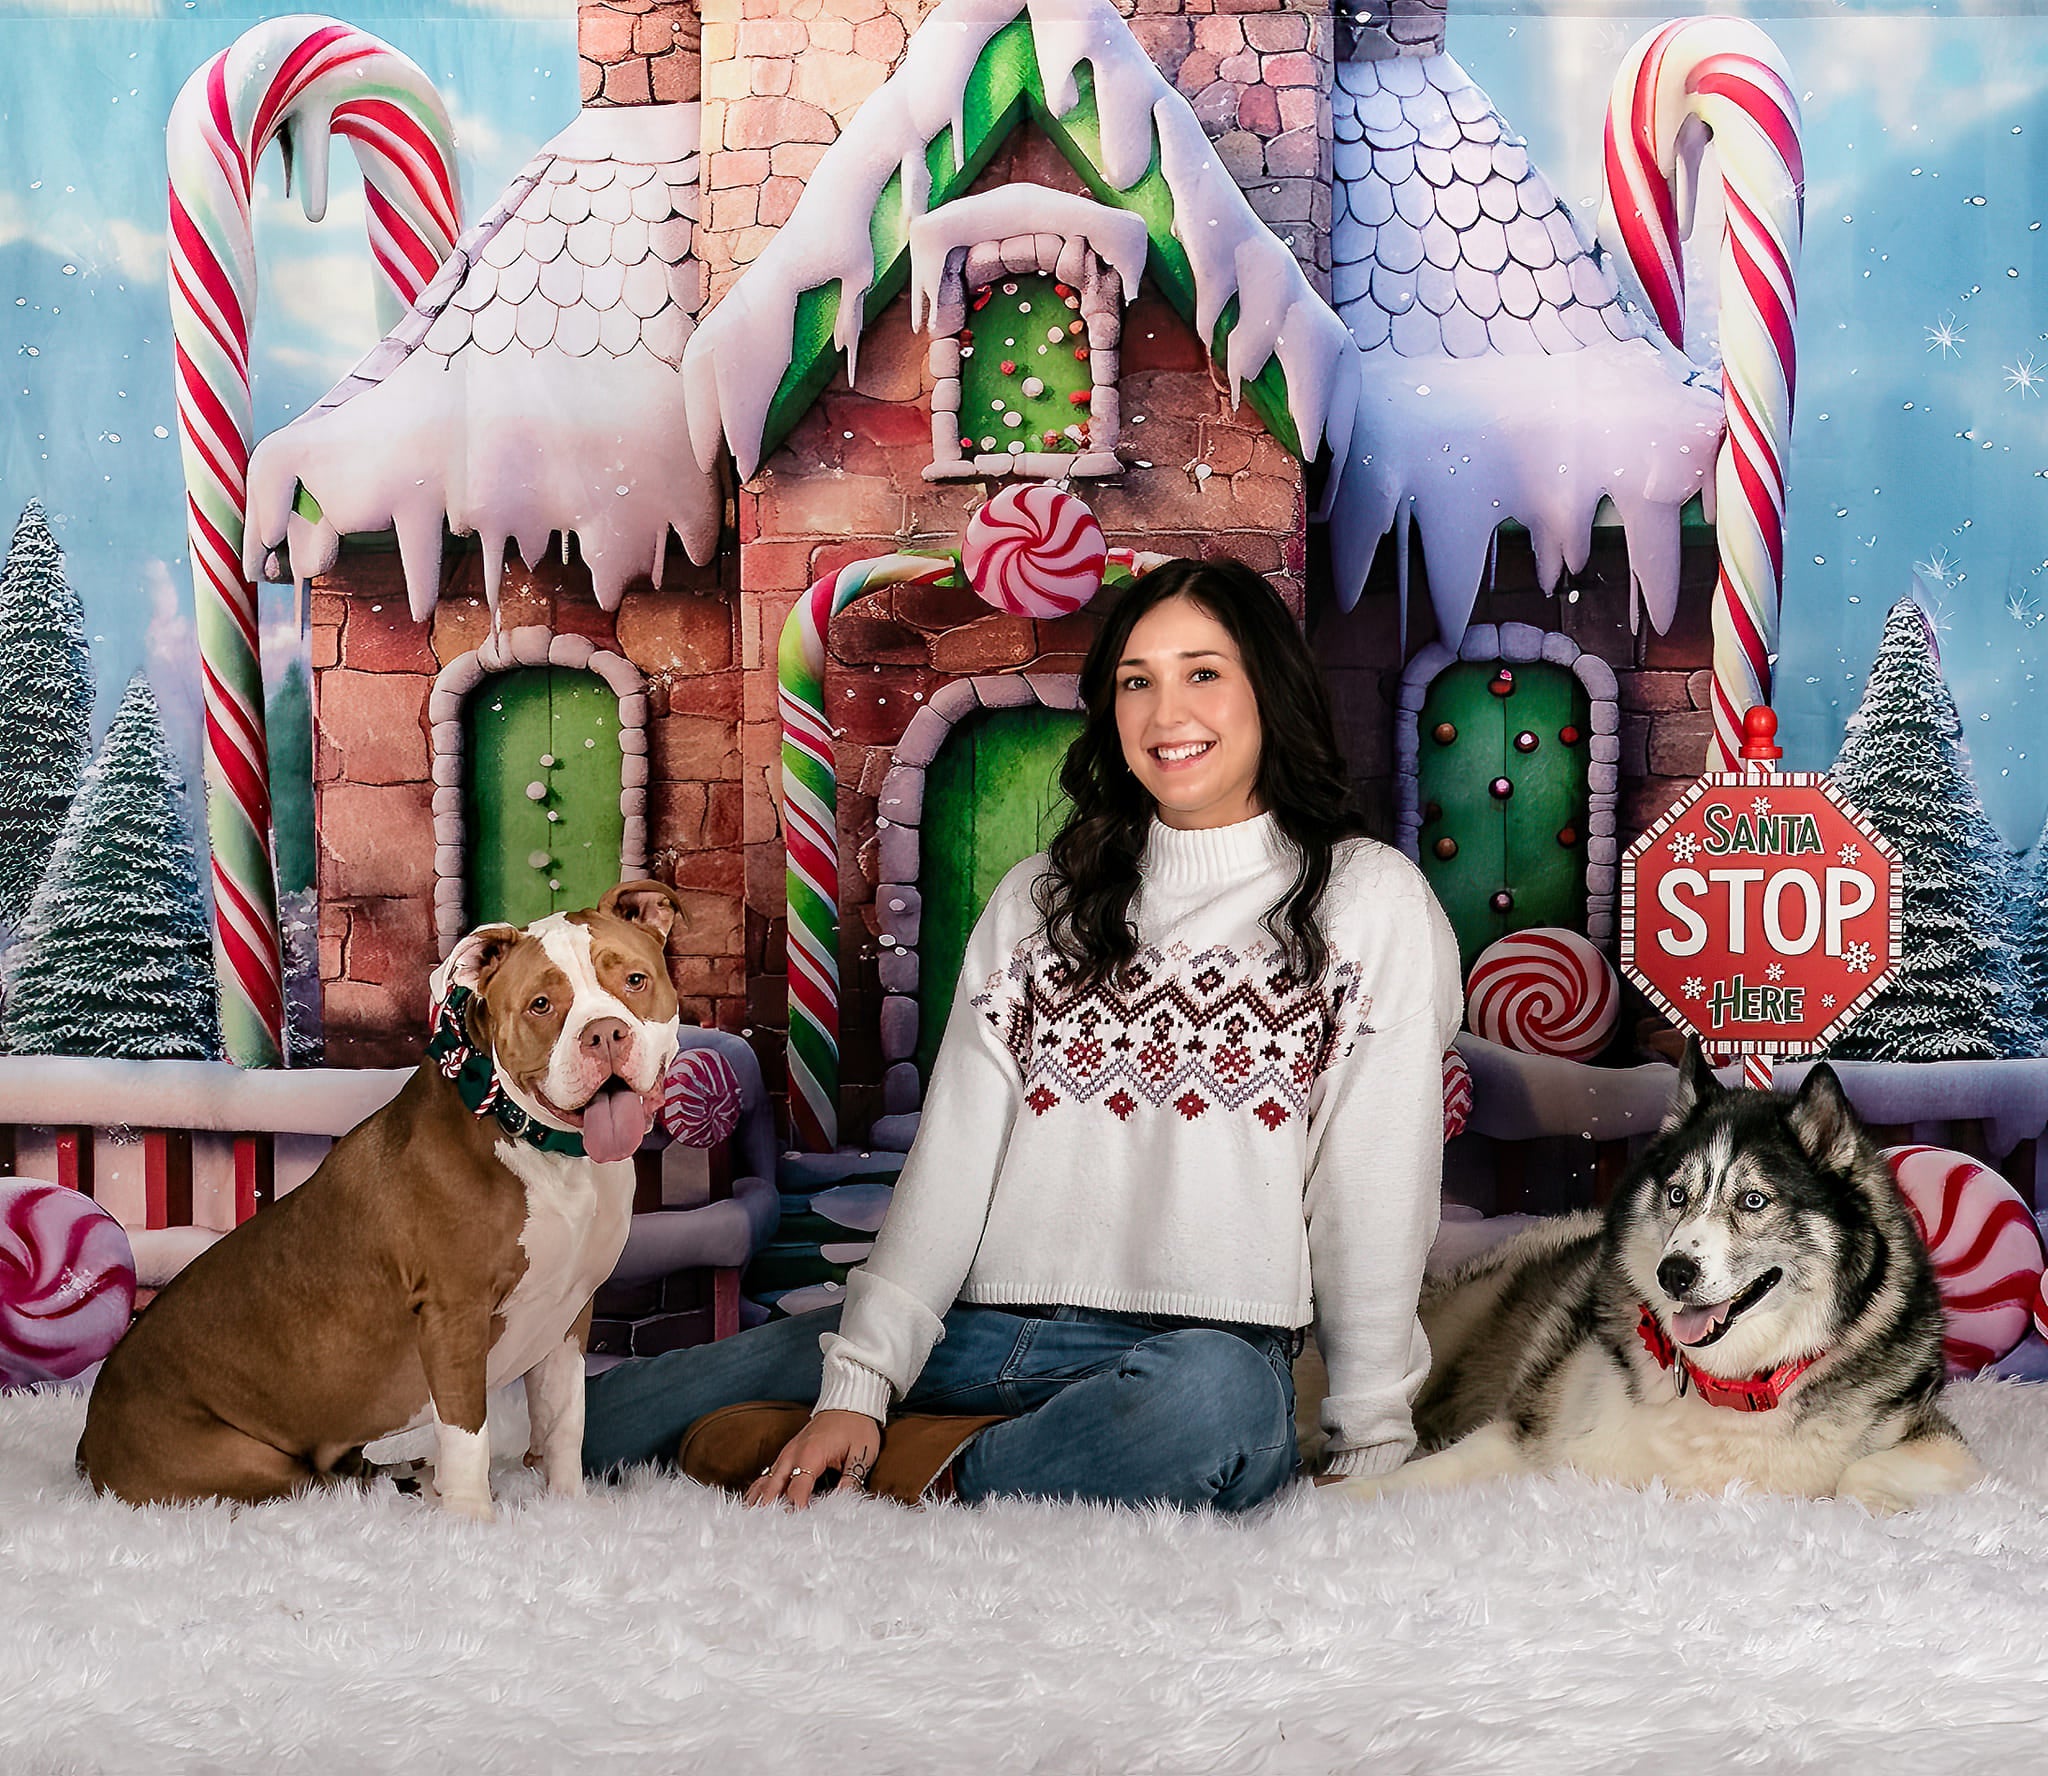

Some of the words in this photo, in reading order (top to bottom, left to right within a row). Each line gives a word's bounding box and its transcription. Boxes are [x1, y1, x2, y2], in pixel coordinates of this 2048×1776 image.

[1703, 803, 1825, 856] SANTA
[1657, 868, 1876, 956] STOP
[1707, 974, 1806, 1029] HERE
